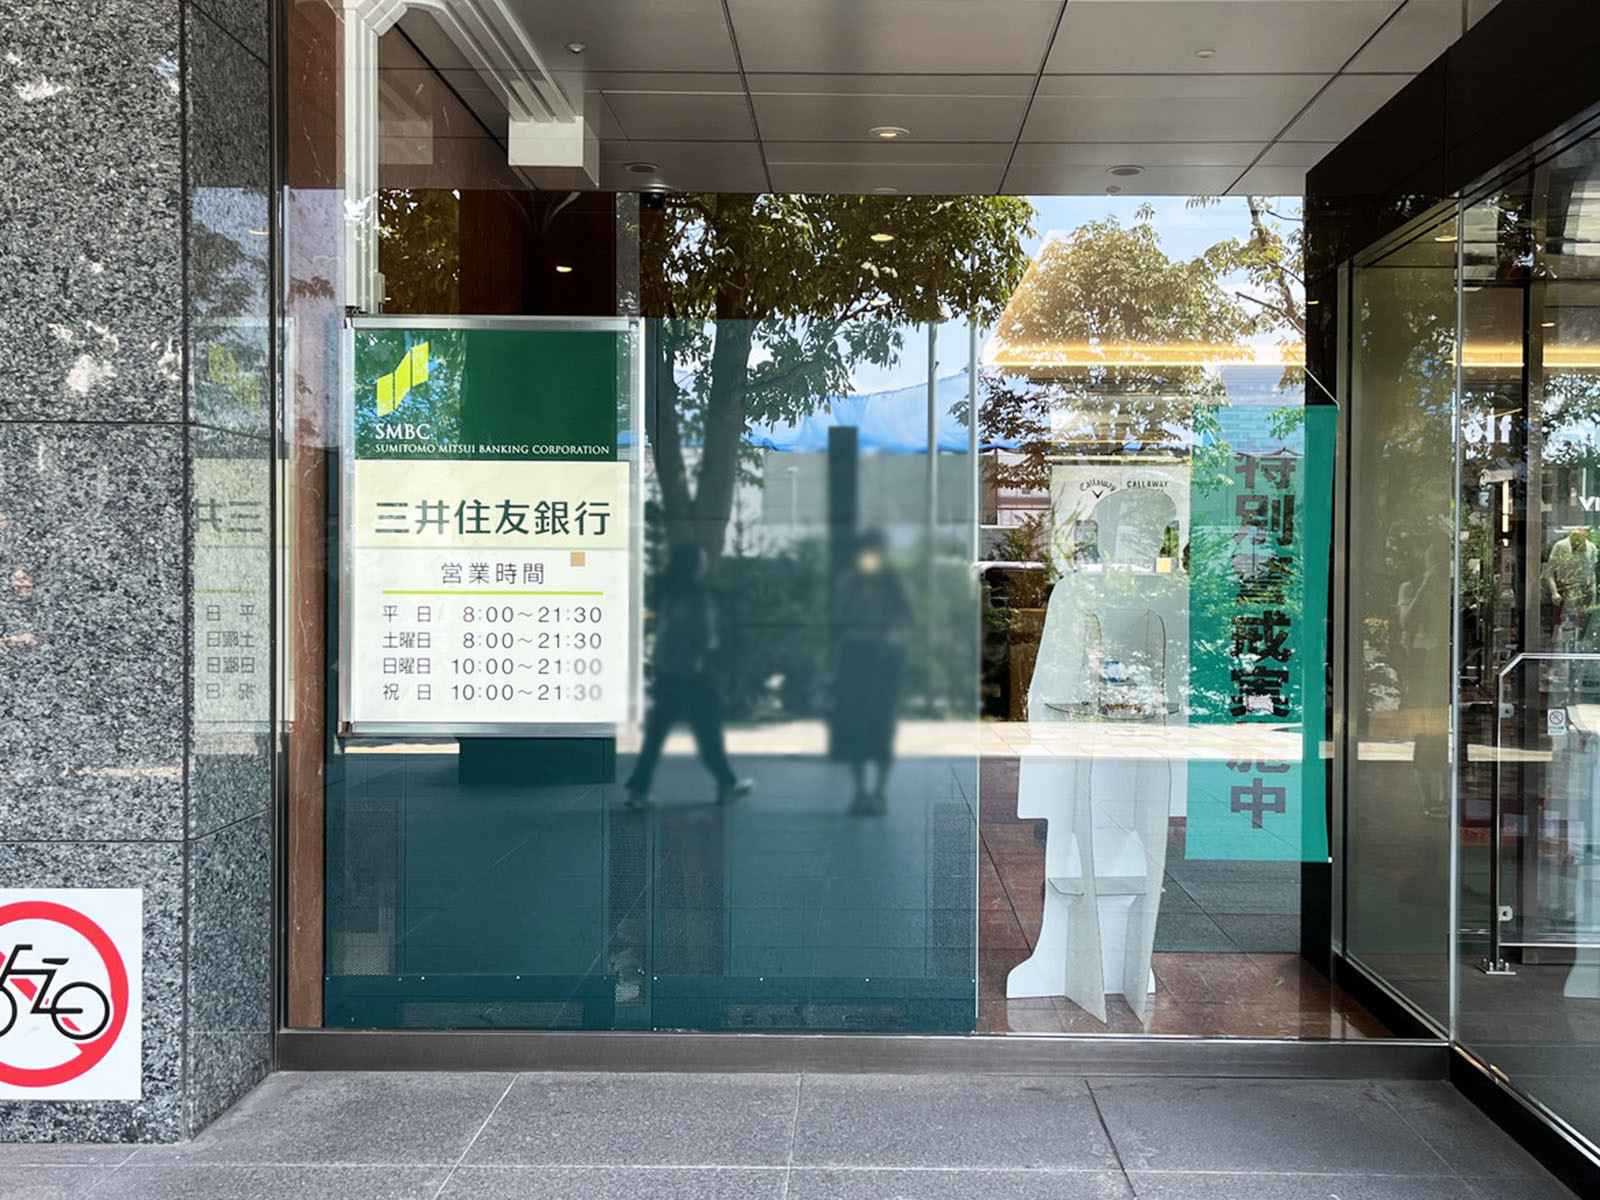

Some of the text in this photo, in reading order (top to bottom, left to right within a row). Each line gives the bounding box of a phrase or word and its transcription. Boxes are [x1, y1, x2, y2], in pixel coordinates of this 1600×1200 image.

[375, 423, 430, 440] SMBC
[375, 443, 610, 455] SUMITOMO MITSUI BANKING CORPORATION
[1126, 480, 1169, 488] CALLAWAY
[375, 499, 611, 535] 三井住友銀行
[441, 562, 545, 585] 営業時間
[382, 632, 431, 649] 土曜日
[1225, 440, 1297, 829] 特別警戒実中
[383, 658, 431, 675] 日曜日
